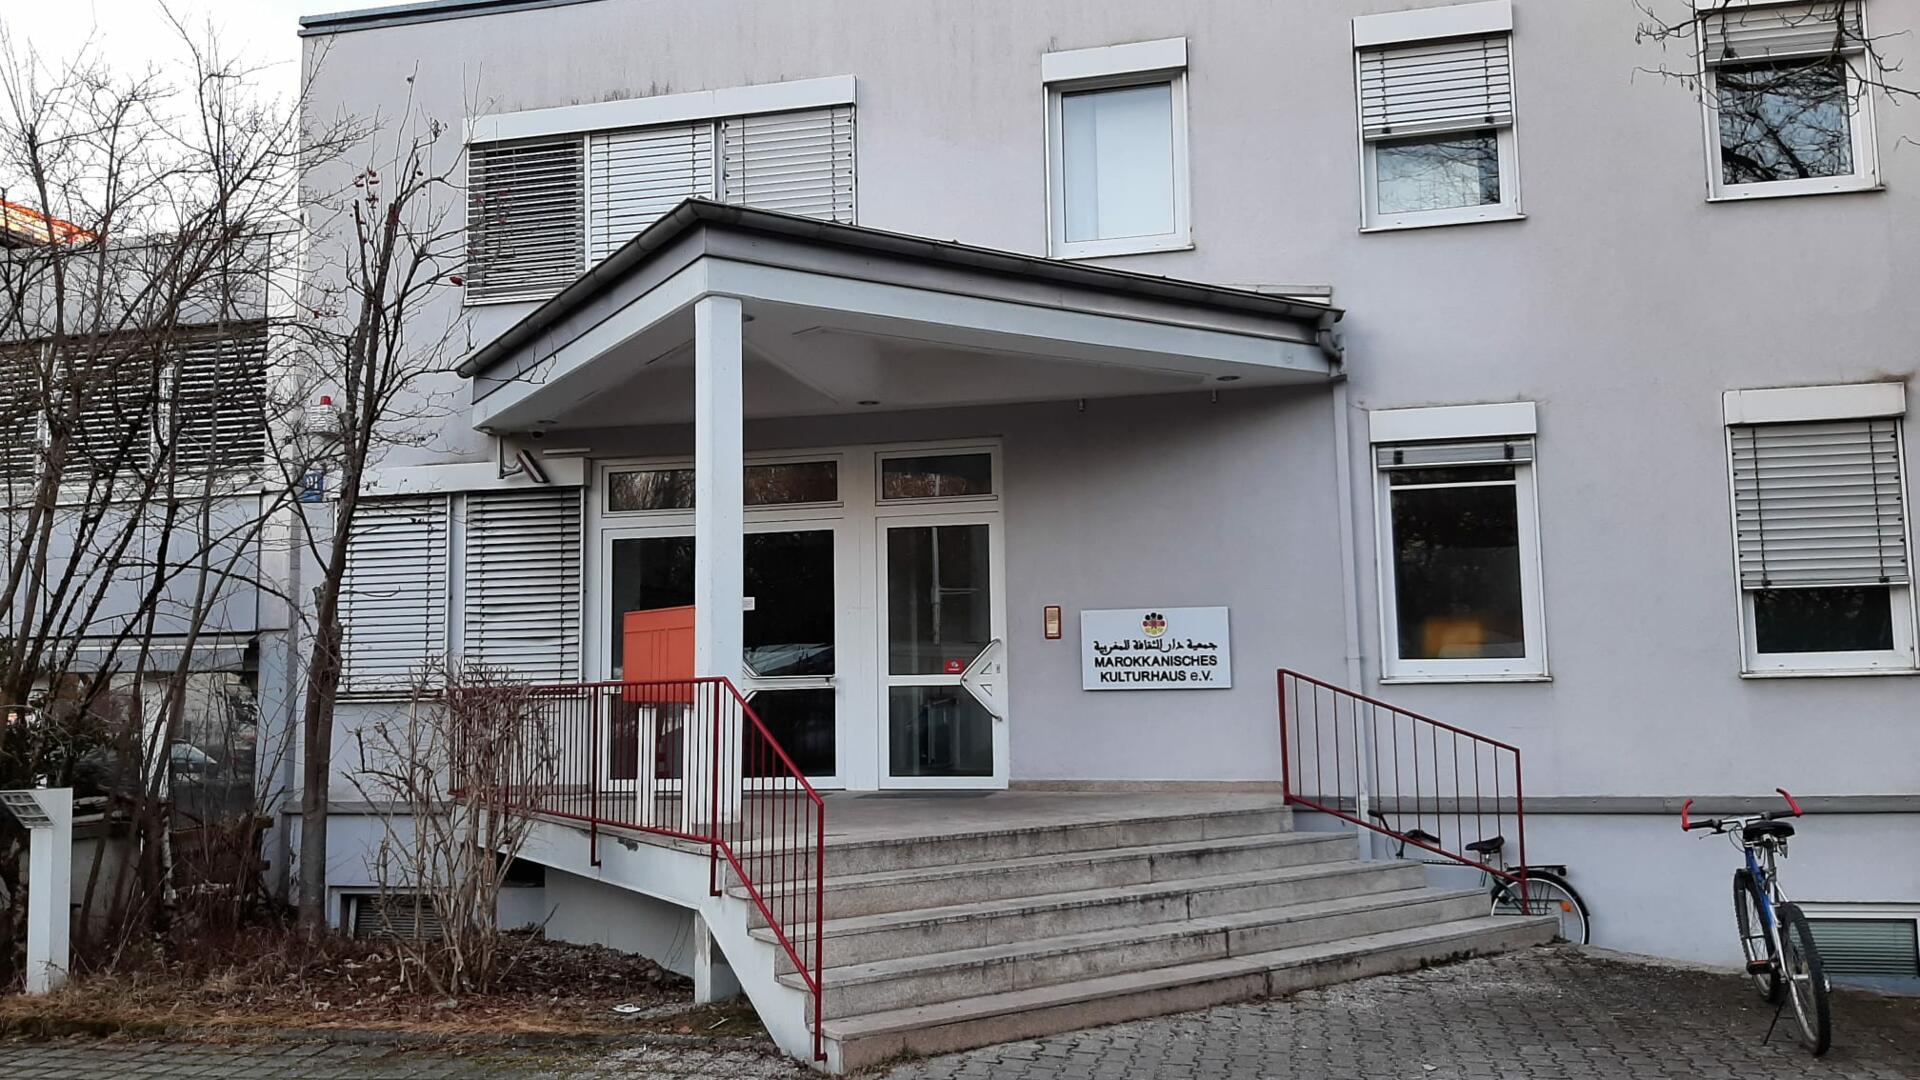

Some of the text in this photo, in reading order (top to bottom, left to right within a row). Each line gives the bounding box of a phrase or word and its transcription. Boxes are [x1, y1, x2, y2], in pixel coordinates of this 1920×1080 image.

[1133, 638, 1163, 651] الثقافة
[1161, 638, 1184, 653] دار
[1186, 638, 1218, 651] جمعية
[1094, 655, 1218, 668] MAROKKANISCHES
[1100, 670, 1213, 683] KULTURHAUS e.V.
